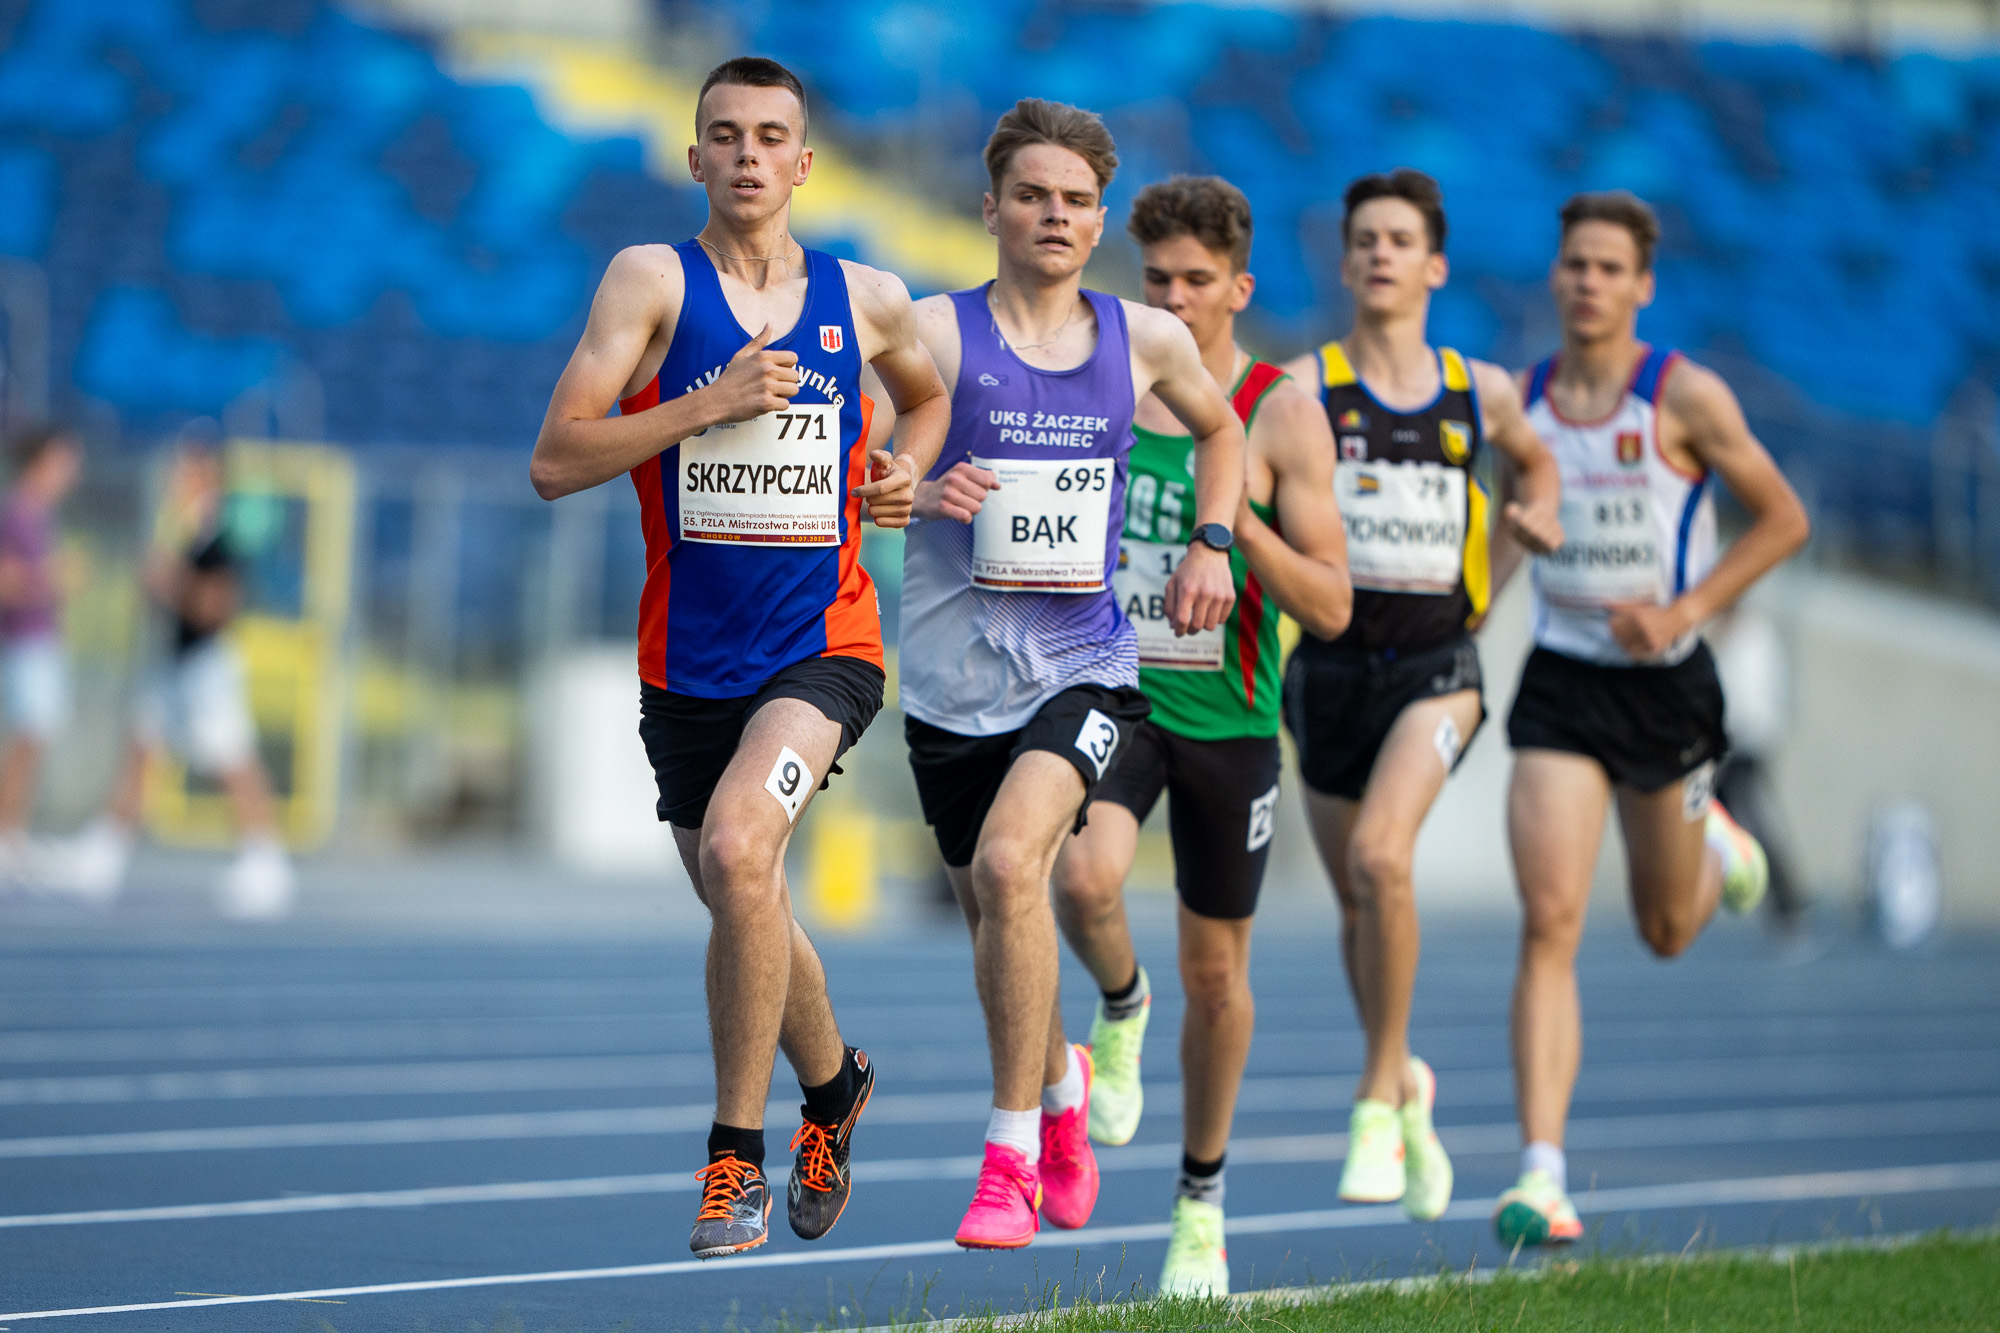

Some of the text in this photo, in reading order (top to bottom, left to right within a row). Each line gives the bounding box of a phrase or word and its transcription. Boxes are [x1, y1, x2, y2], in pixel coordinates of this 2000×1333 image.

[776, 414, 827, 440] 771
[989, 410, 1110, 433] UKS ŻACZEK
[1000, 428, 1094, 449] POŁANIEC
[686, 462, 833, 495] SKRZYPCZAK
[1055, 467, 1106, 492] 695
[683, 516, 837, 531] 55. PZLA Mistrzostwa Polski U18
[696, 510, 736, 518] Ogólnopolska
[701, 532, 741, 541] CHORZÓW
[1011, 515, 1079, 549] BĄK
[1011, 567, 1069, 577] Mistrzostwa
[1090, 722, 1114, 764] 3
[777, 760, 801, 797] 9
